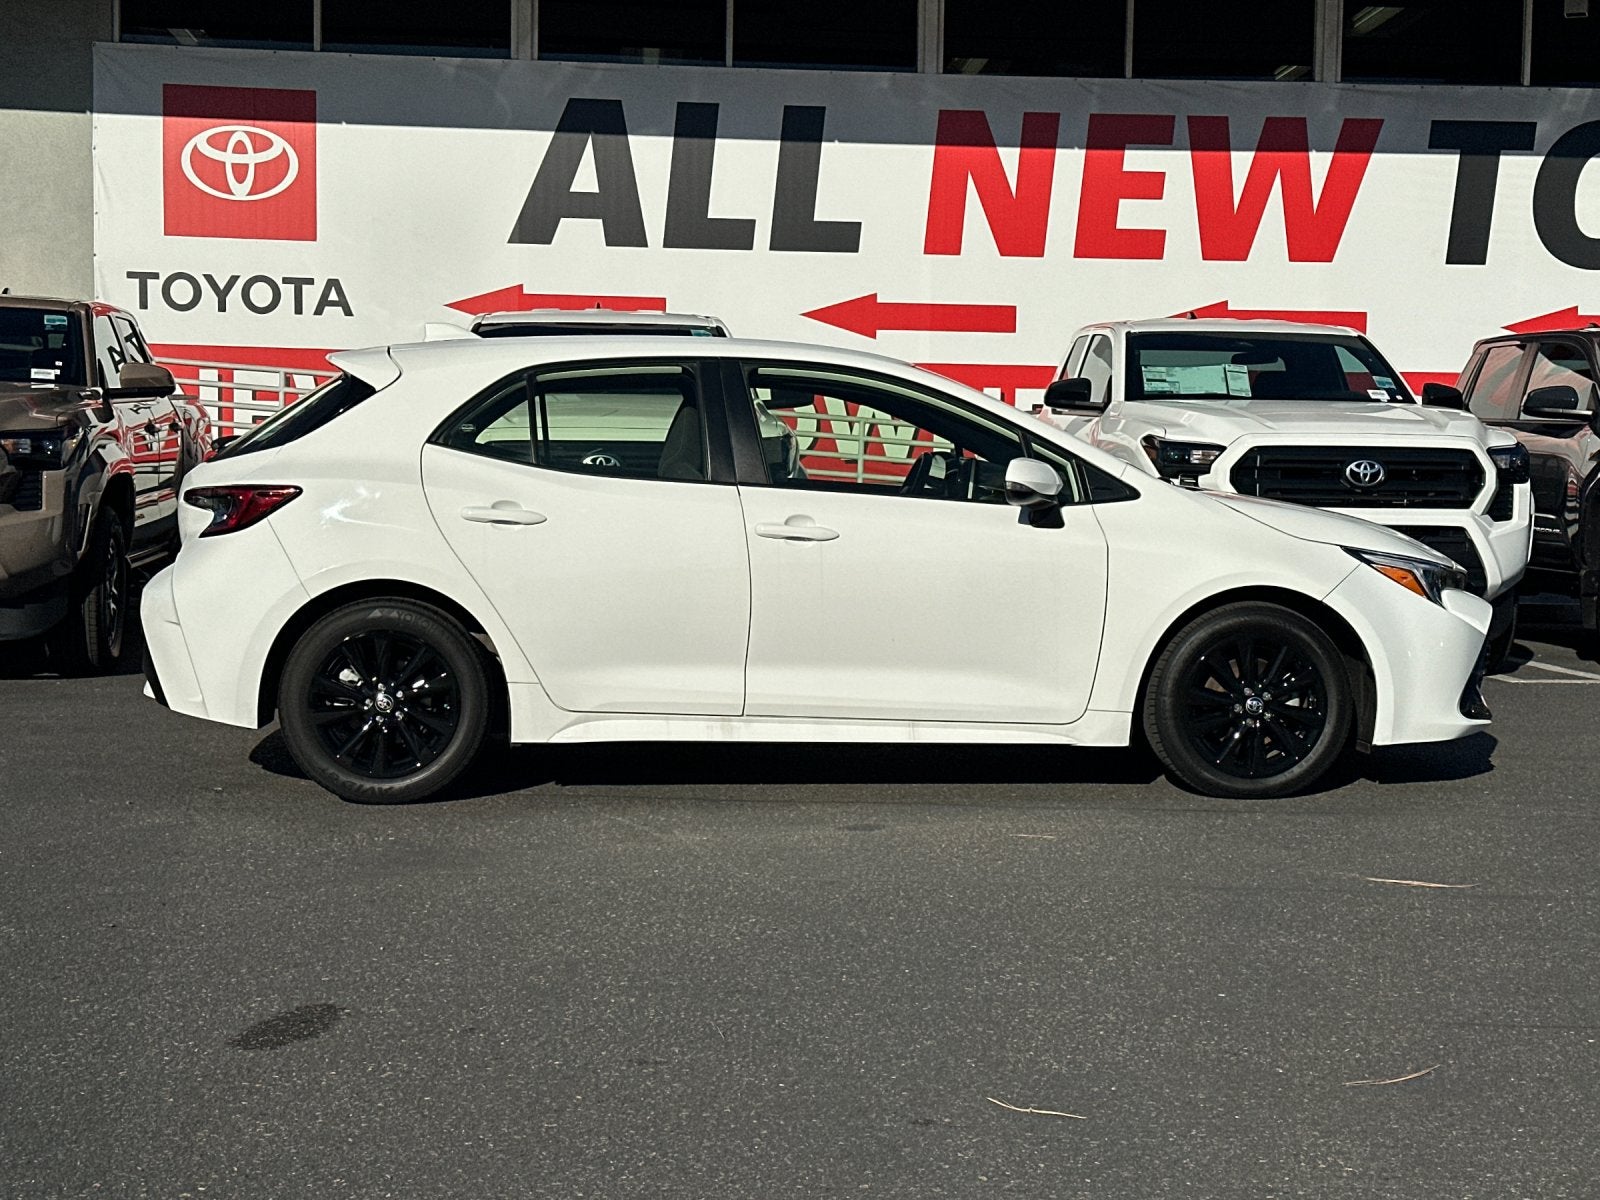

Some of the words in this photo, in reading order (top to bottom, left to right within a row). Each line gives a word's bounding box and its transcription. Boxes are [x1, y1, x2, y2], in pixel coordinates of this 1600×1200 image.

[507, 97, 863, 253] ALL
[924, 110, 1384, 263] NEW
[126, 271, 354, 317] TOYOTA
